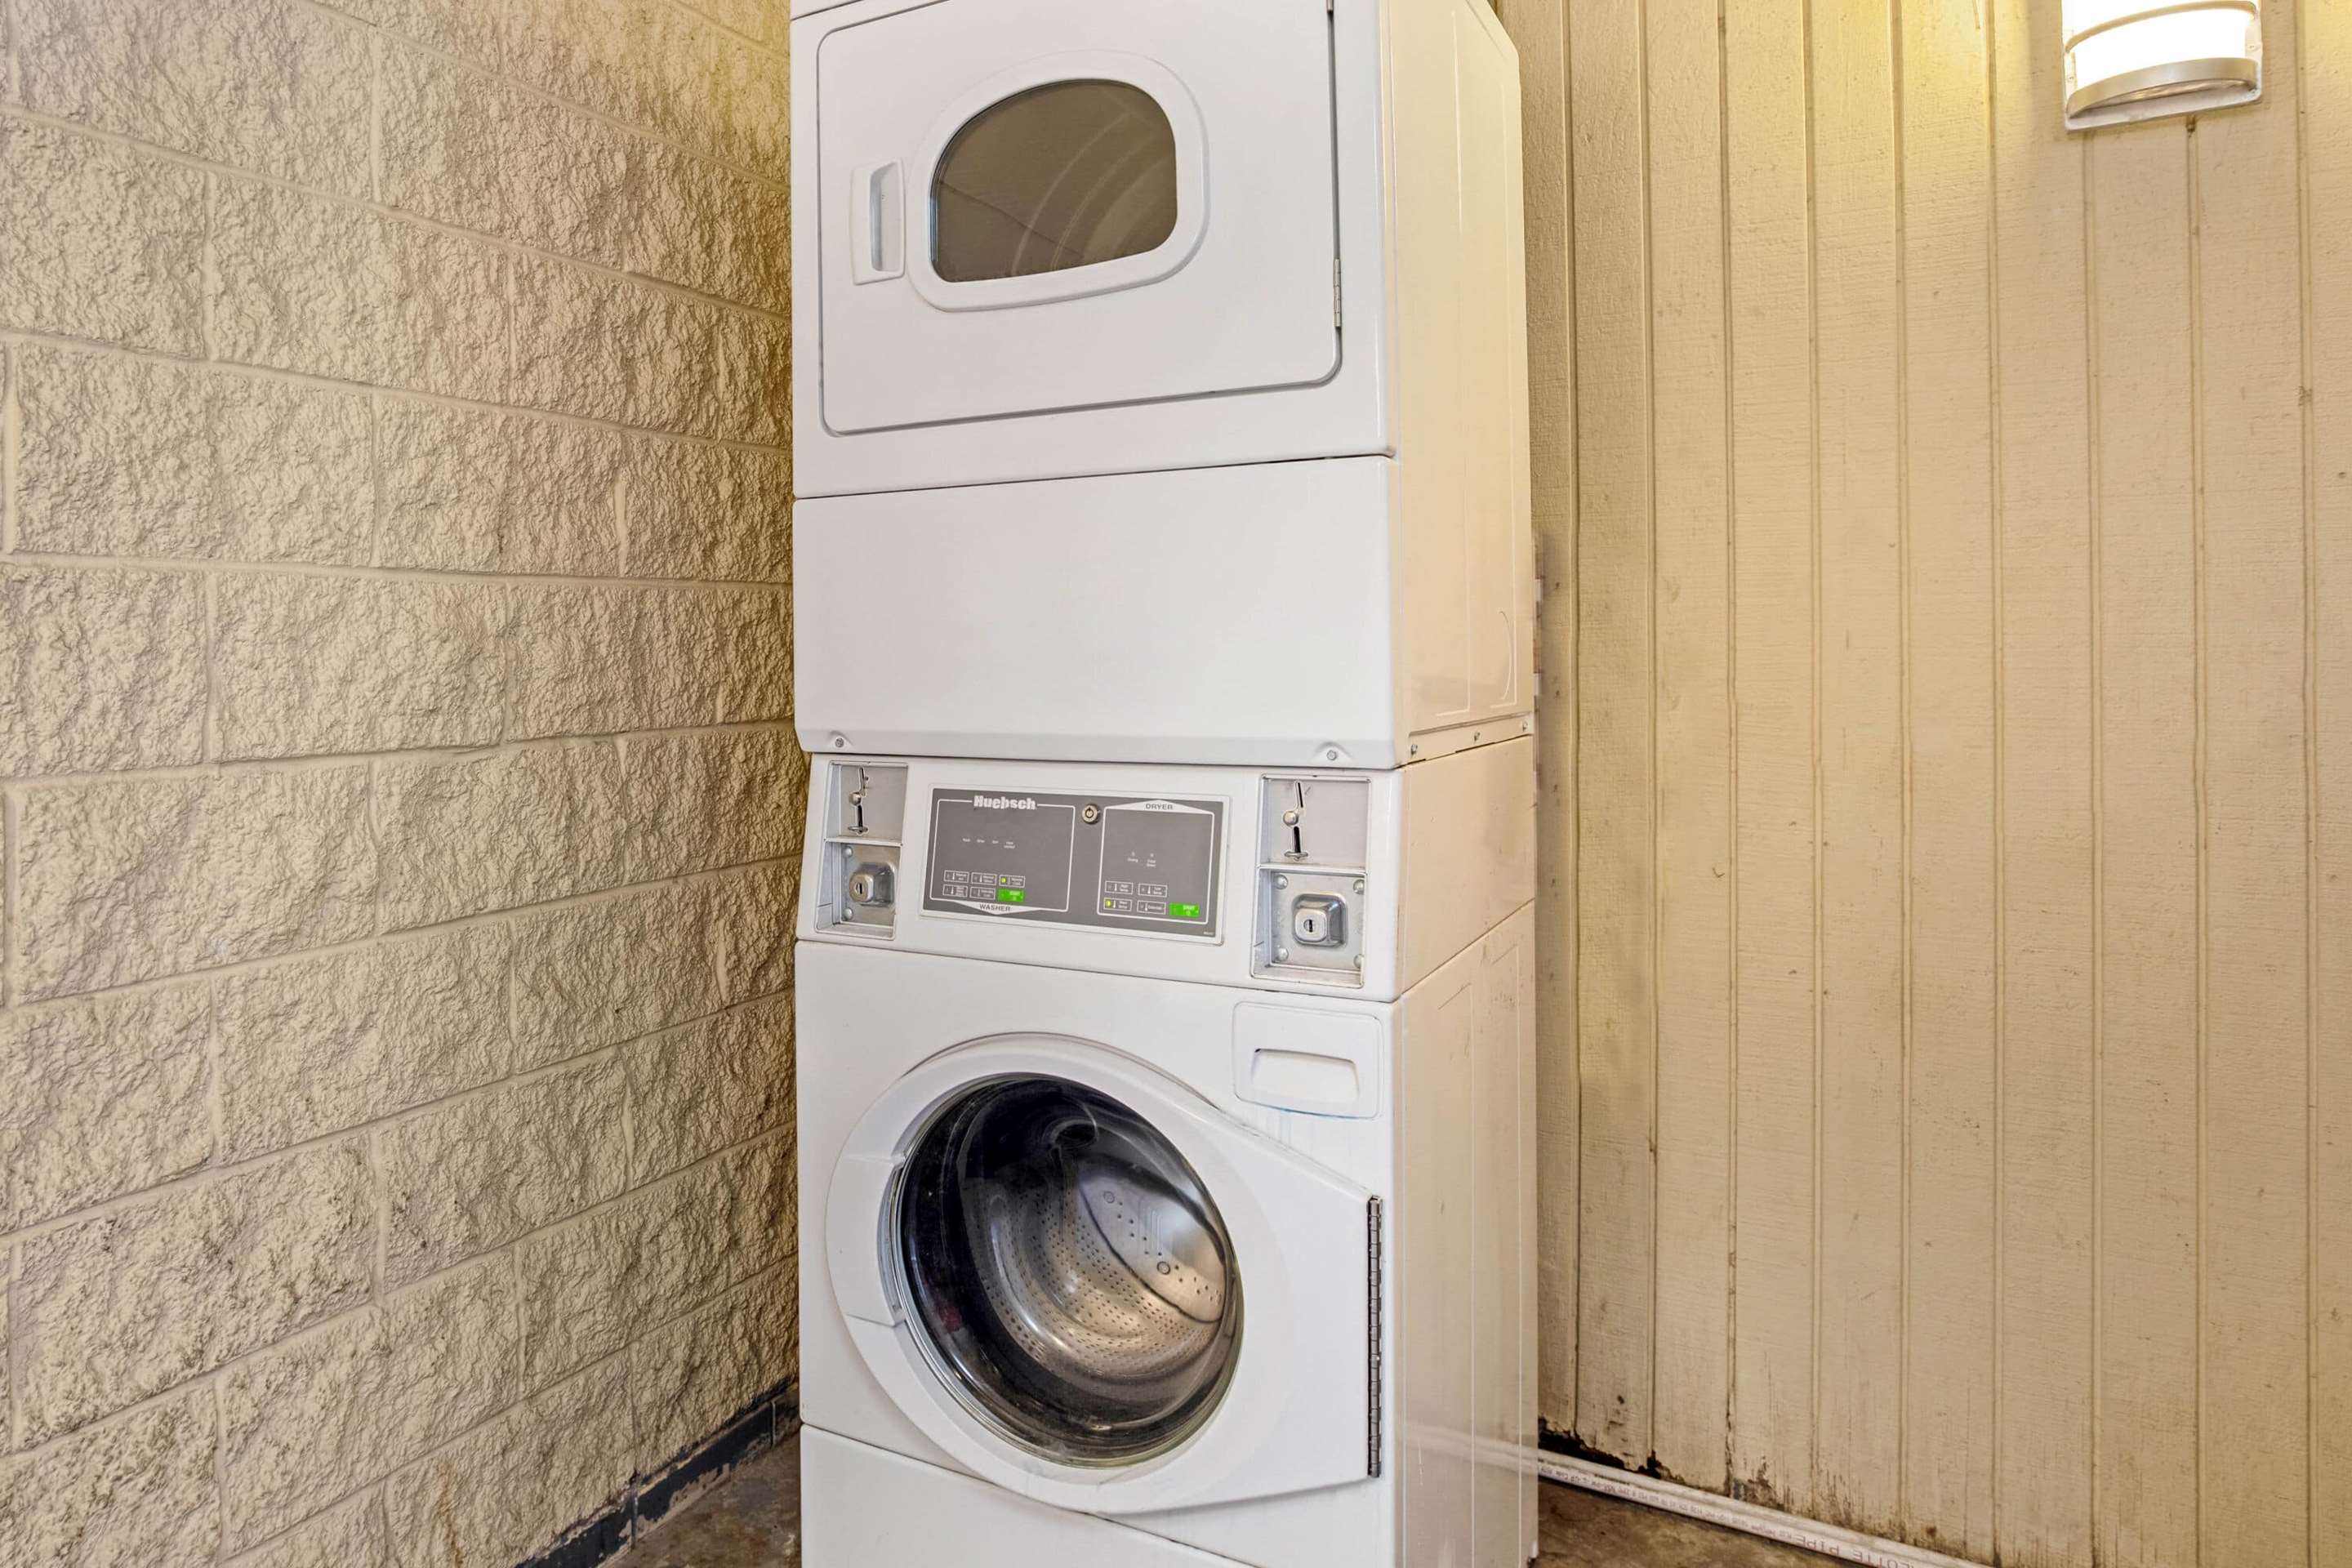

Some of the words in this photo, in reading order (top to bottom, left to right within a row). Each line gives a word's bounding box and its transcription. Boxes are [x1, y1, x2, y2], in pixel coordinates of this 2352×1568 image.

[973, 795, 1036, 810] Huebsch
[980, 902, 1010, 911] WASHER
[1793, 1535, 1839, 1556] PIPE
